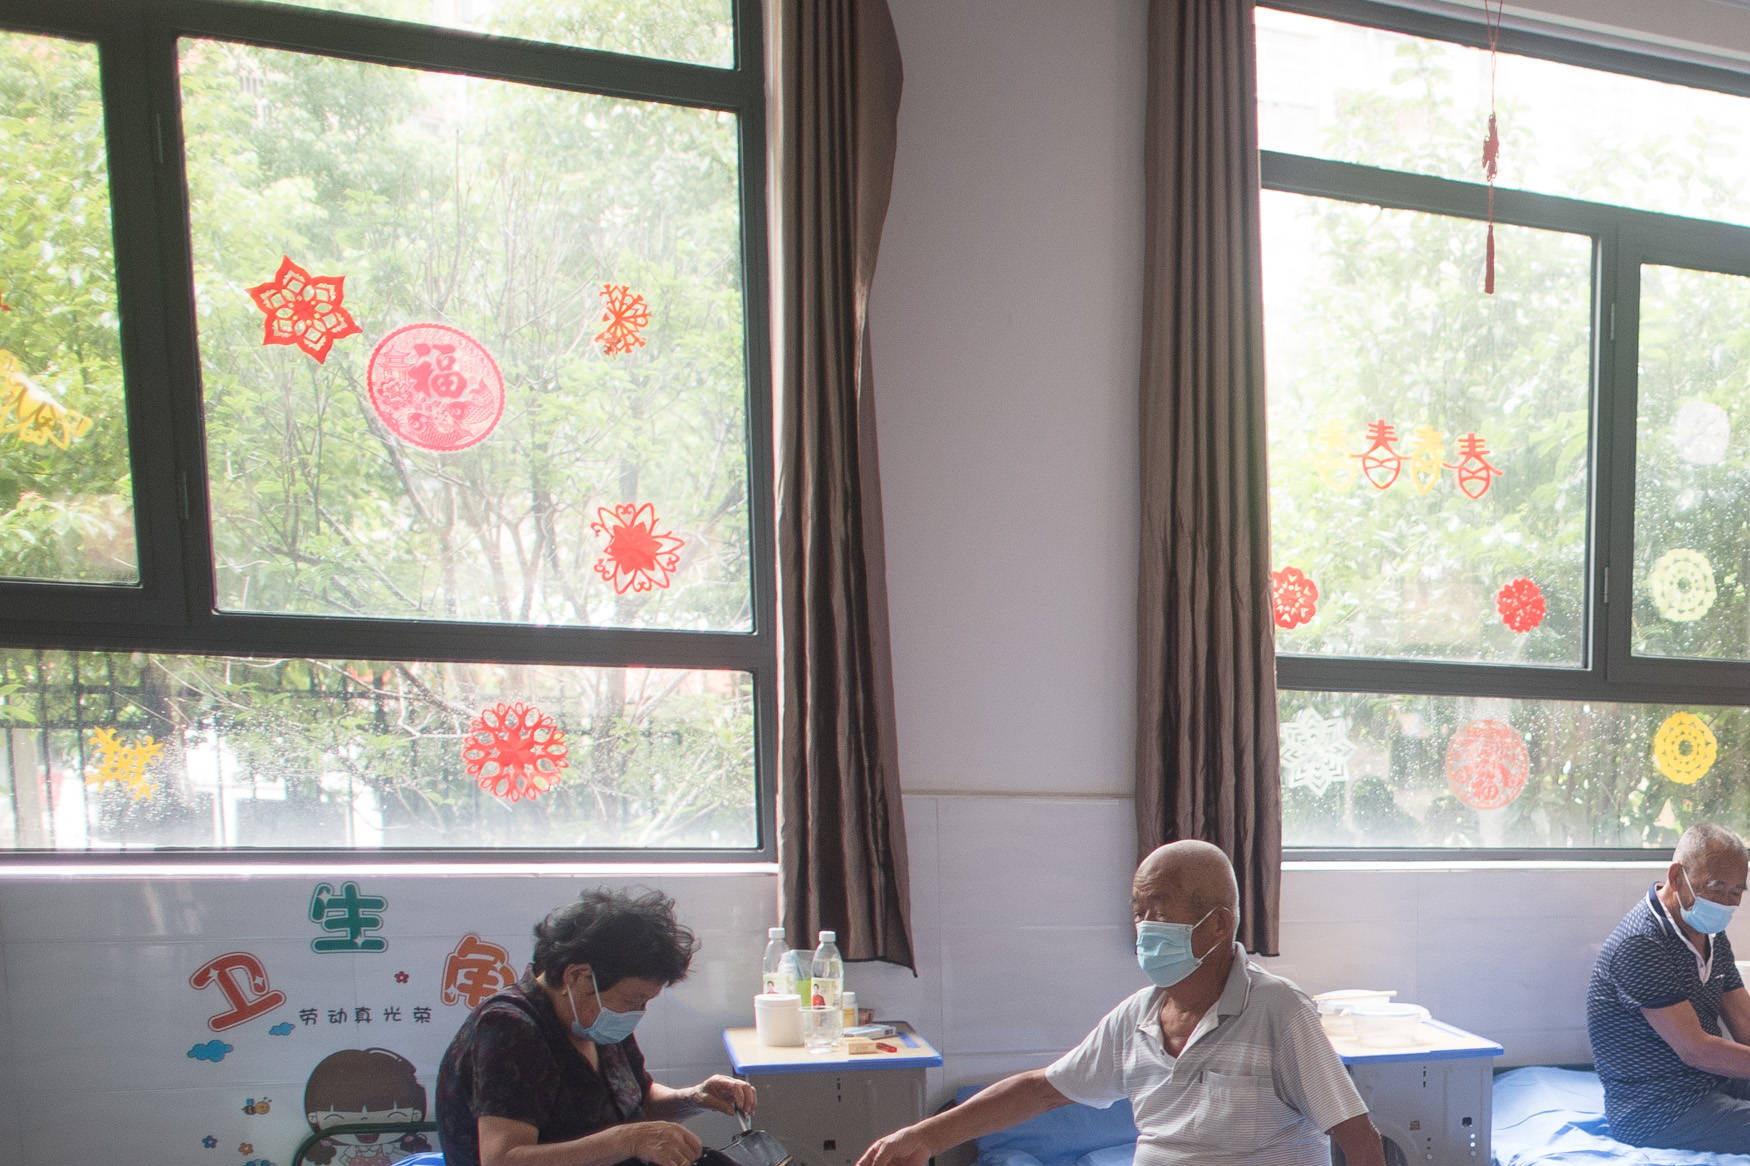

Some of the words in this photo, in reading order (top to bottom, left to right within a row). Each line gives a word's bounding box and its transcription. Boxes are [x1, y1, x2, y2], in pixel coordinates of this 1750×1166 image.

[408, 343, 467, 398] 福
[1351, 419, 1411, 489] 春
[1444, 433, 1504, 499] 春
[298, 1006, 432, 1025] 劳动真光荣
